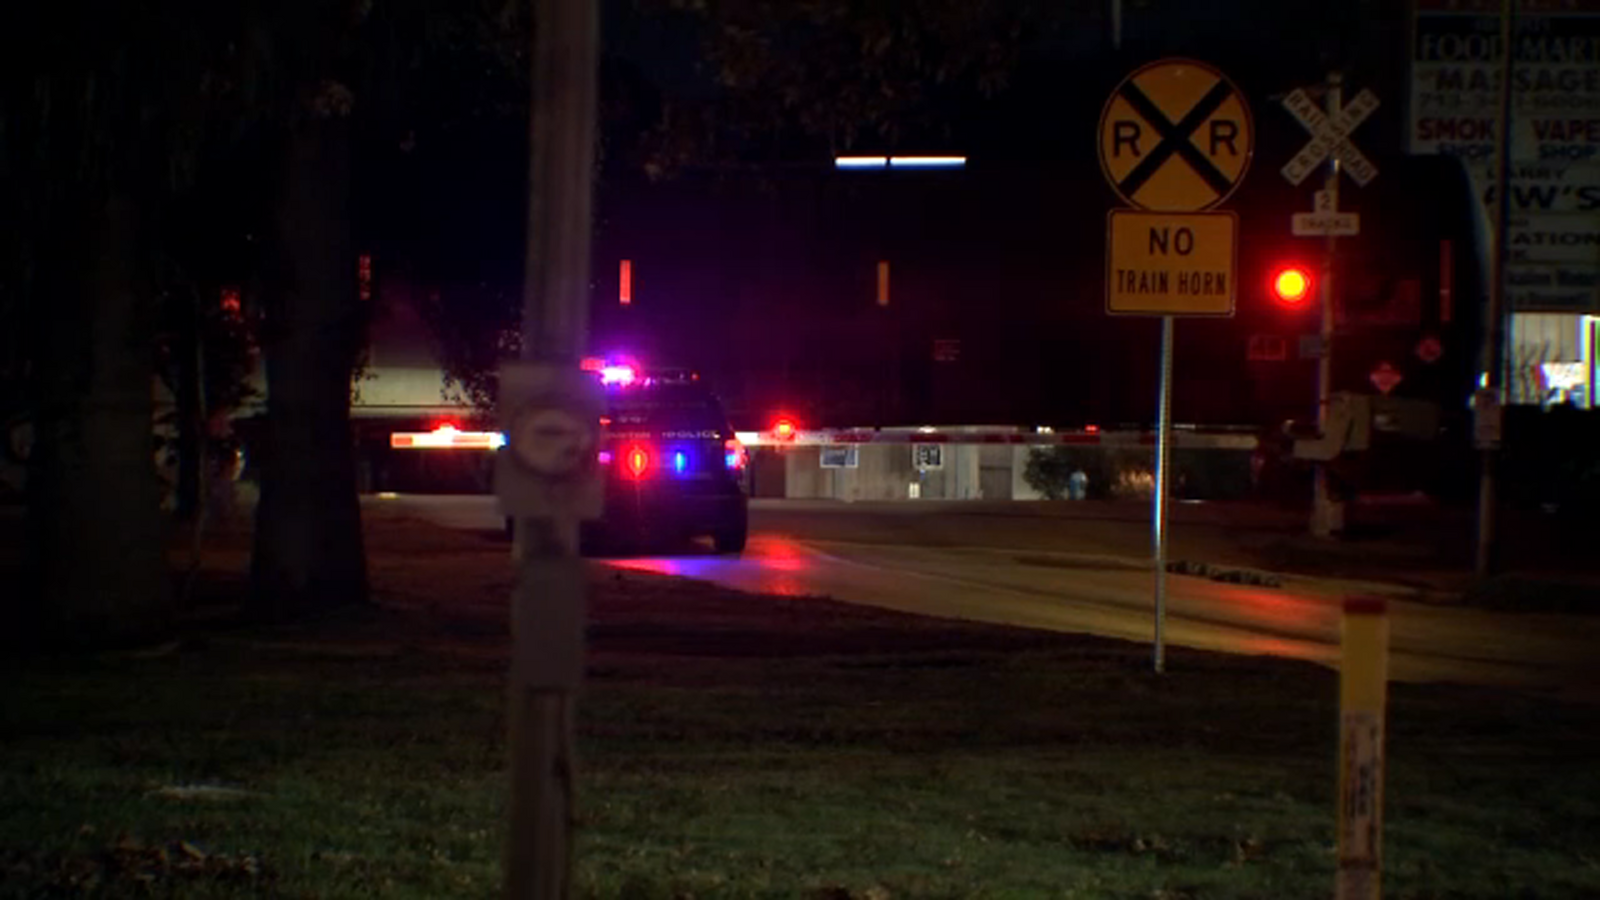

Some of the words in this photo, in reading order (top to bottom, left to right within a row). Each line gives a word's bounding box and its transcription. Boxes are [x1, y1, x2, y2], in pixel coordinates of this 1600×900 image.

[1113, 121, 1141, 157] R
[1210, 120, 1237, 156] R
[1418, 118, 1496, 141] SMOK
[1531, 119, 1600, 142] VAPE
[1539, 144, 1597, 159] SHOP
[1320, 192, 1331, 210] 2
[1149, 227, 1194, 256] NO
[1117, 269, 1169, 294] TRAIN
[1177, 271, 1226, 296] HORN
